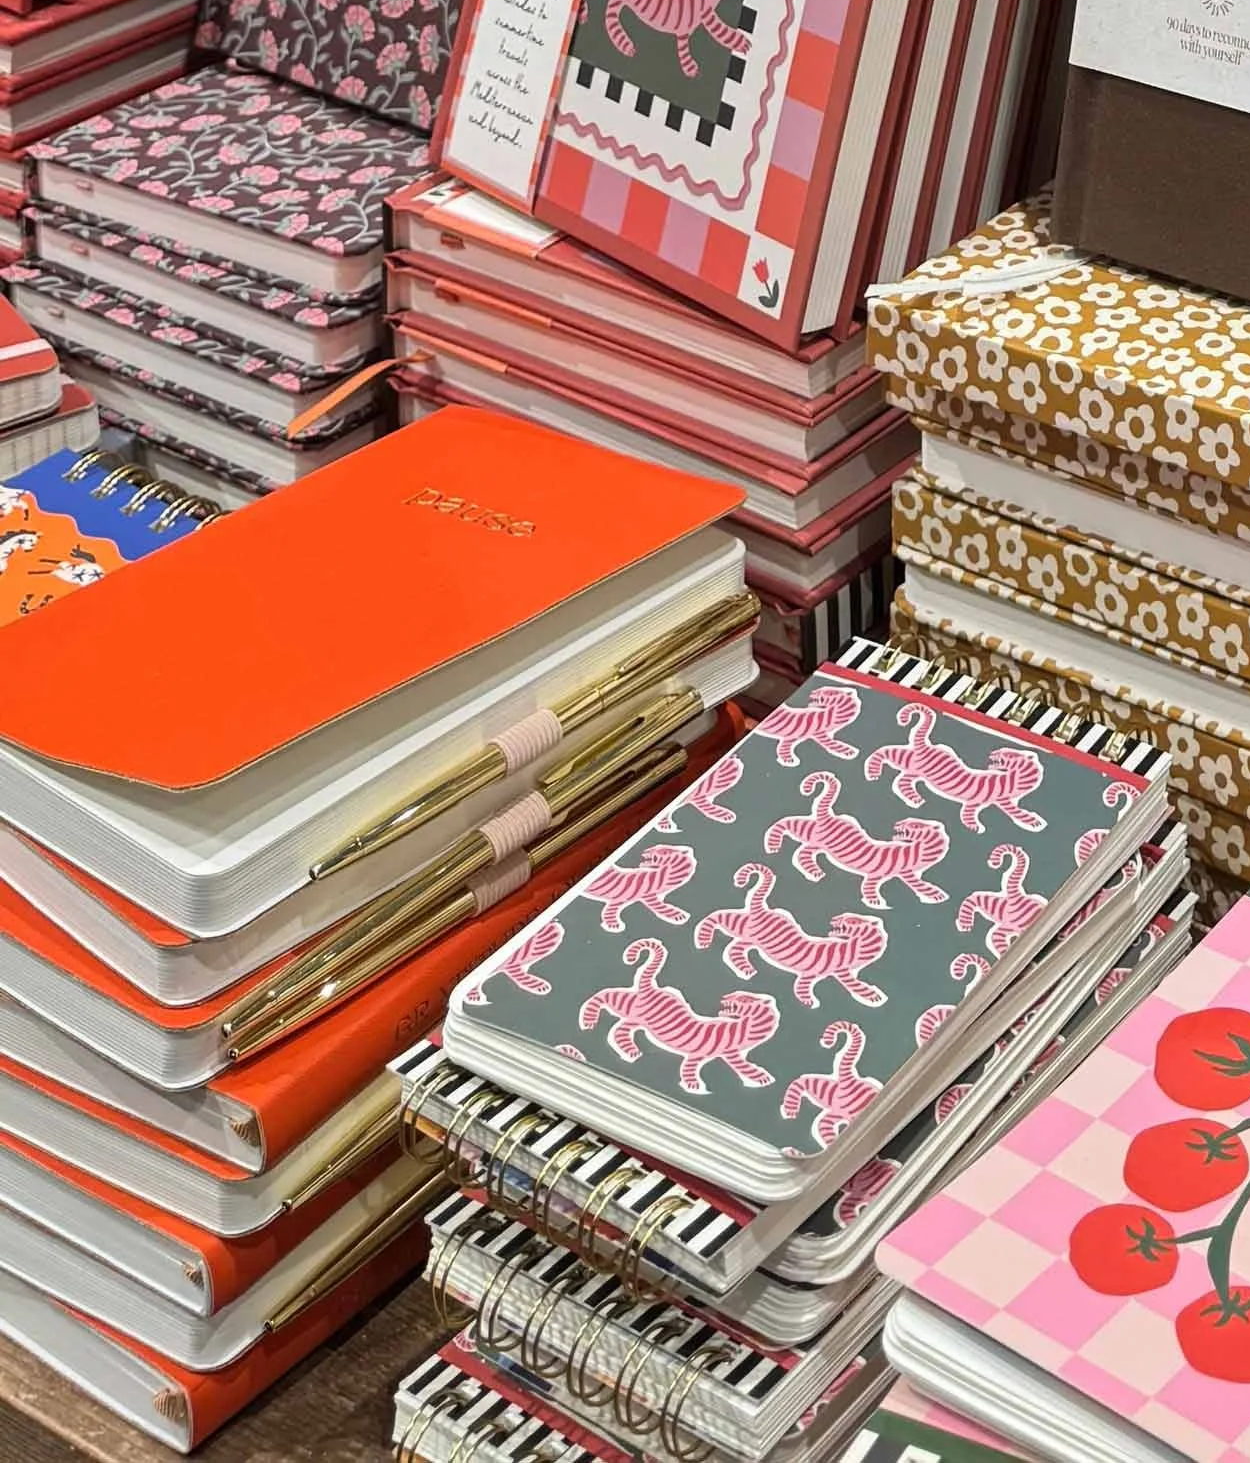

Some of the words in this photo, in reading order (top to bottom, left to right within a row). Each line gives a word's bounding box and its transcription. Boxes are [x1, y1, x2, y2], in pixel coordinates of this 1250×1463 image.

[1166, 16, 1179, 31] 90
[1180, 17, 1201, 37] days
[1201, 26, 1212, 38] to
[1180, 38, 1201, 54] with
[1201, 44, 1244, 66] yourself
[402, 487, 536, 539] pause
